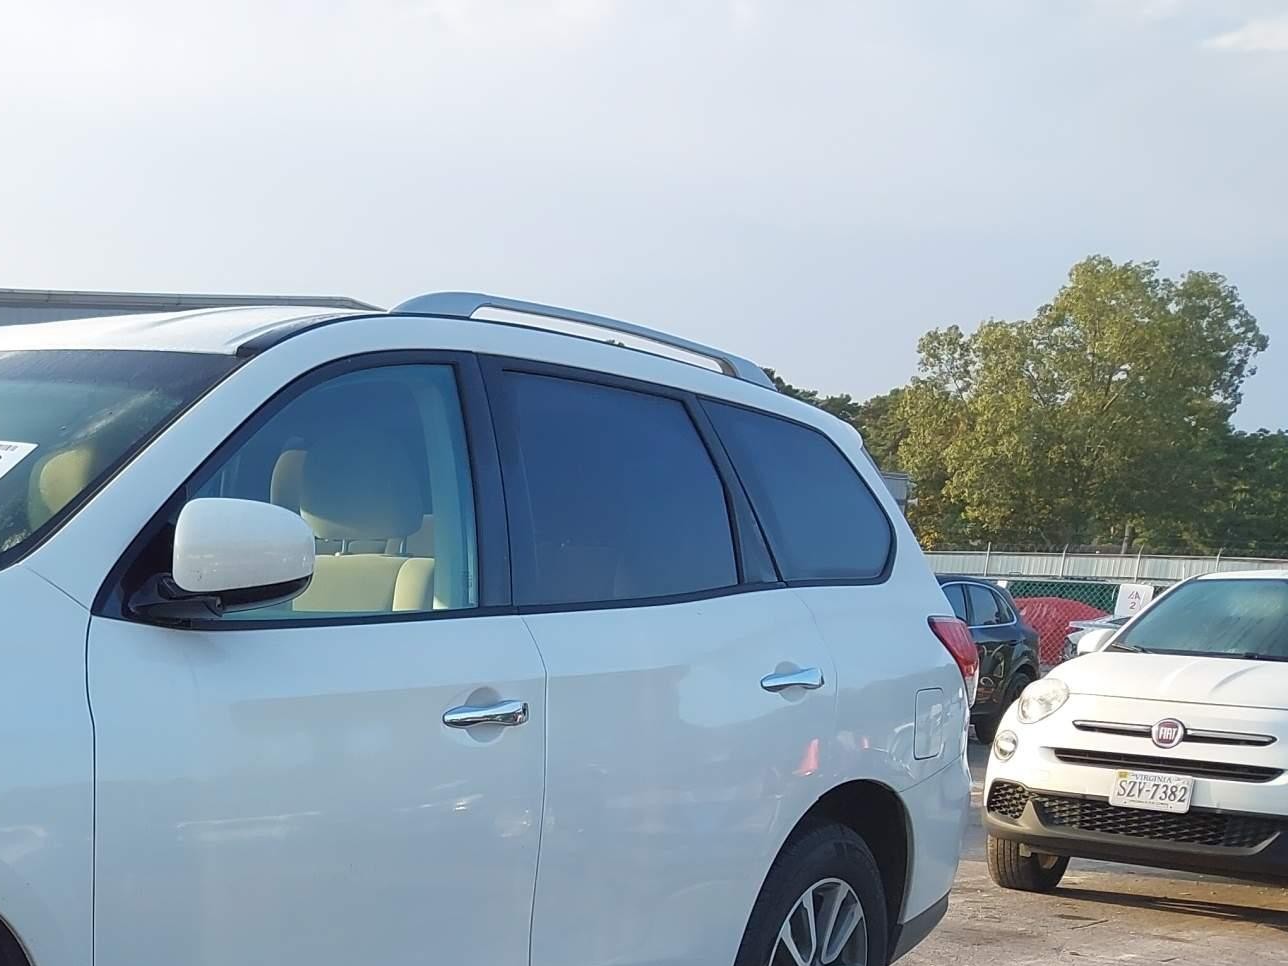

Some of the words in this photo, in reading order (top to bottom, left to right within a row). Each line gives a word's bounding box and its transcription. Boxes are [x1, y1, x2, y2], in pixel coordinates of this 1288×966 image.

[1129, 601, 1136, 609] 2
[1158, 727, 1178, 740] FIAT
[1135, 774, 1172, 783] VIRGINIA
